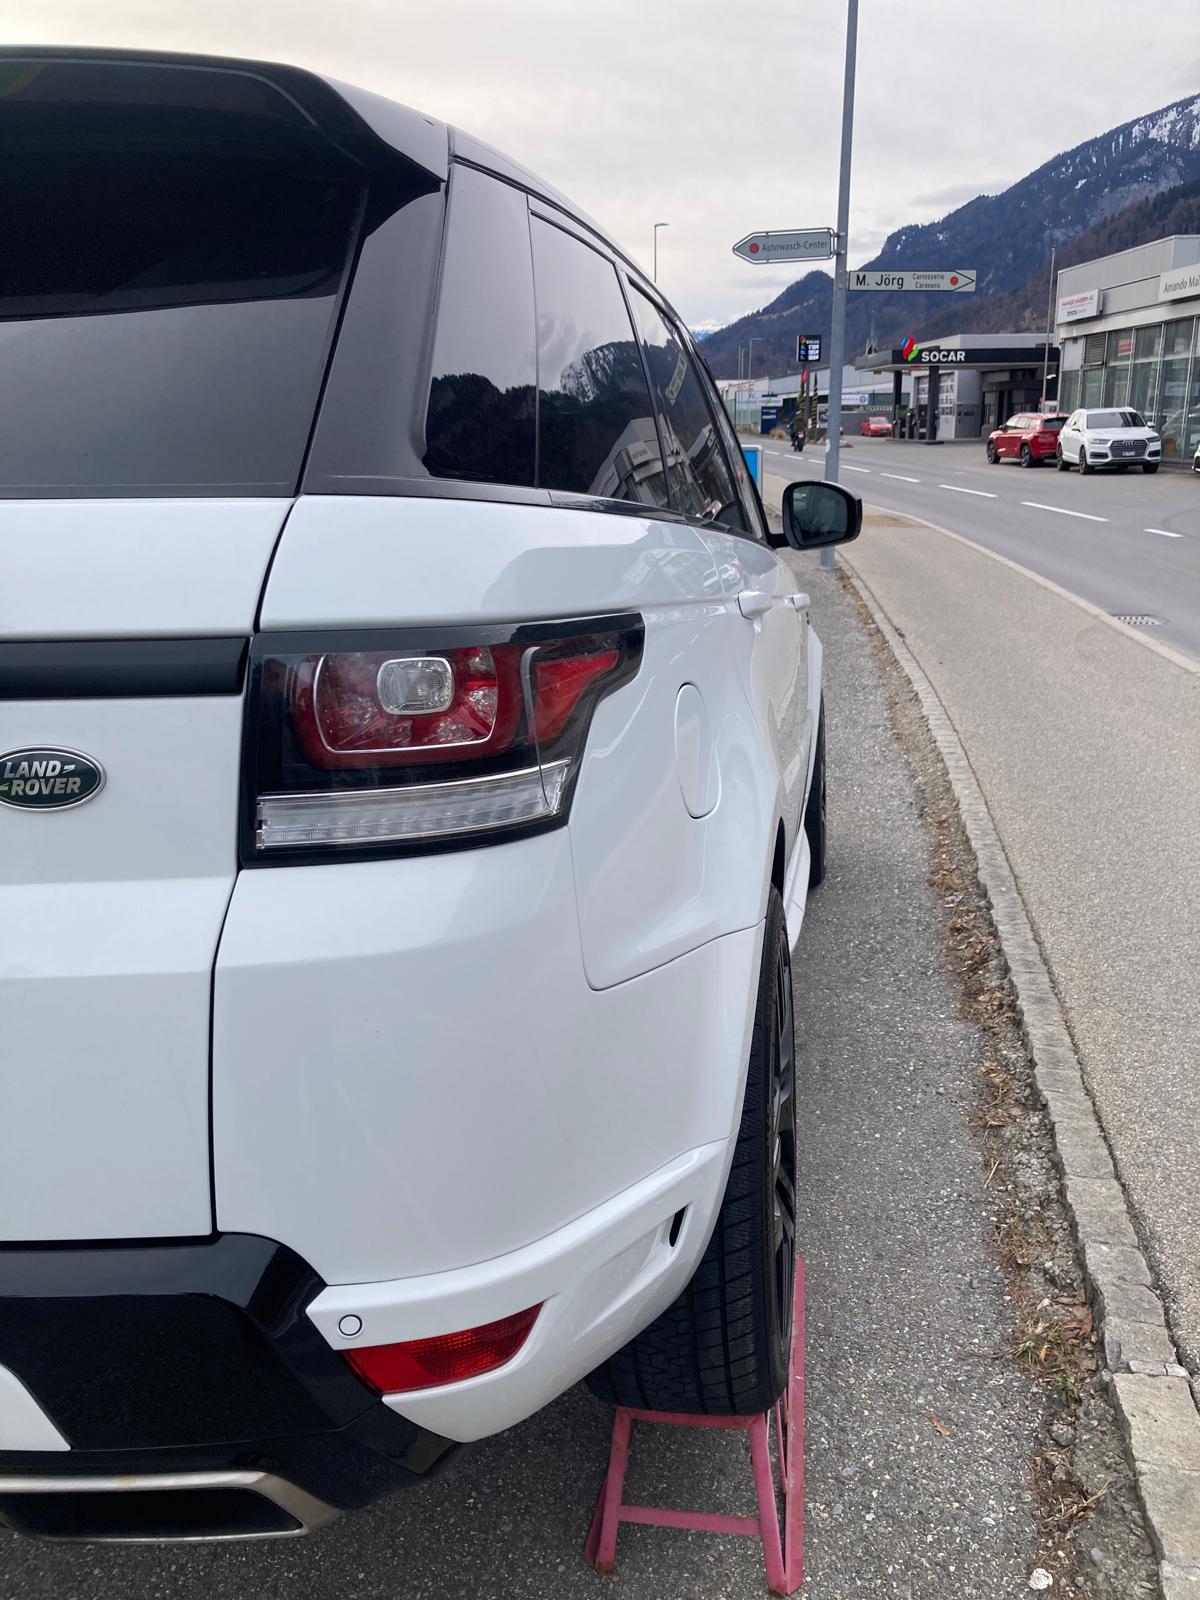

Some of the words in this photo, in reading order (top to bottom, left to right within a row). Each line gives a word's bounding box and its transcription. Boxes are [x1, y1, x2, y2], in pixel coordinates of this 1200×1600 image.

[762, 240, 828, 253] Autowasch-Center
[856, 274, 870, 286] M.
[875, 273, 904, 289] Jörg
[912, 272, 945, 280] Carrosserie
[1163, 278, 1188, 294] Amando
[921, 351, 966, 362] SOCAR
[3, 760, 61, 778] LAND
[11, 777, 81, 796] ROVER
